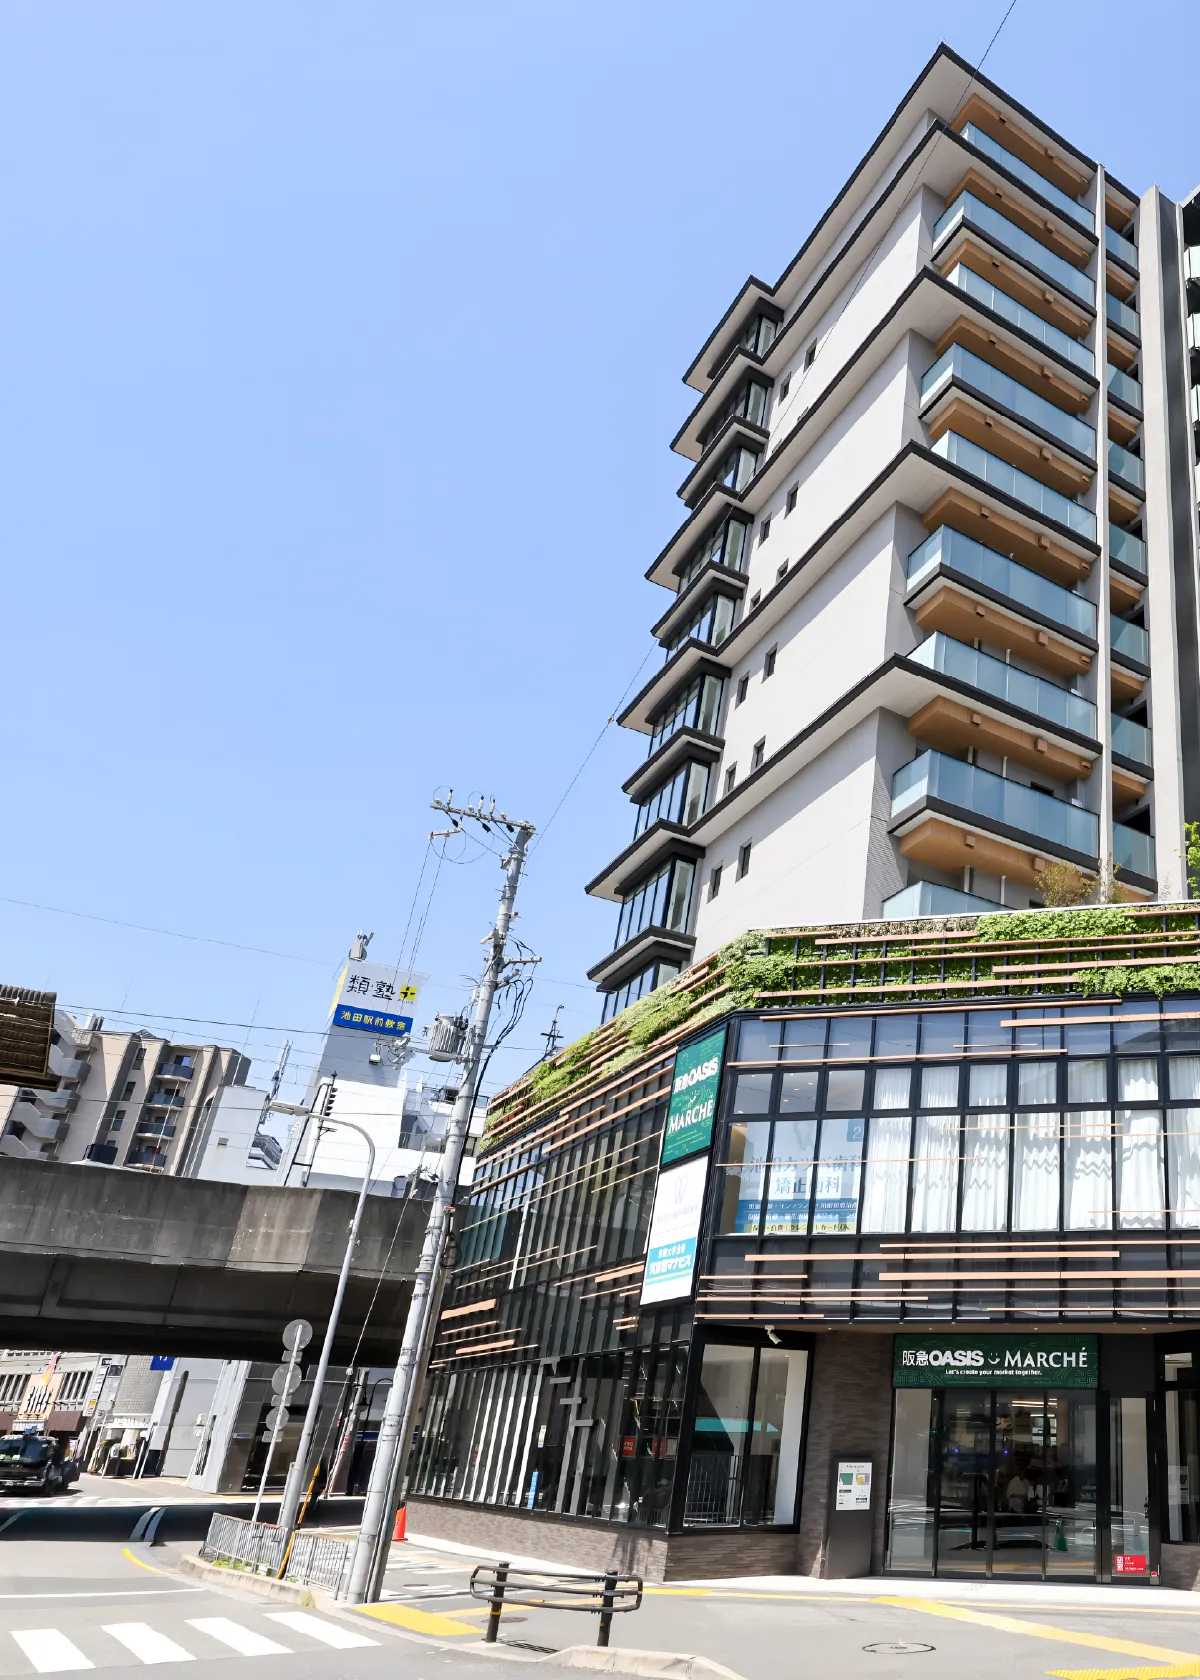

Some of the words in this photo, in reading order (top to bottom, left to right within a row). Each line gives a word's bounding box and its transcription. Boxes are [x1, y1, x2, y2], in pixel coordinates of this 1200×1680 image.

[347, 974, 396, 1000] 類塾
[341, 1010, 406, 1031] 池田駅前教室
[668, 1094, 714, 1135] MARCHÉ
[902, 1350, 984, 1367] 阪急OASIS
[1004, 1347, 1088, 1368] MARCHÉ
